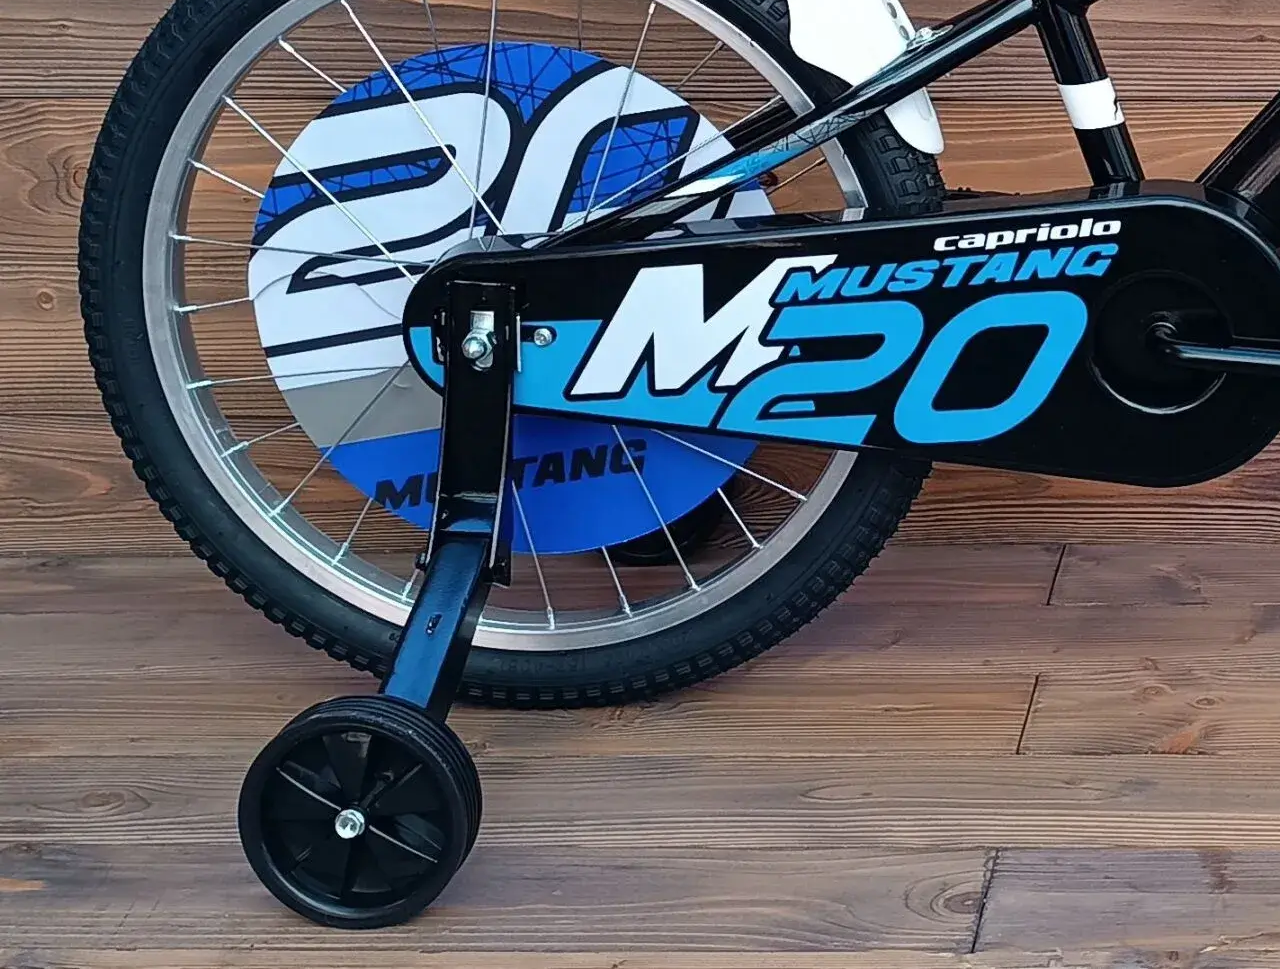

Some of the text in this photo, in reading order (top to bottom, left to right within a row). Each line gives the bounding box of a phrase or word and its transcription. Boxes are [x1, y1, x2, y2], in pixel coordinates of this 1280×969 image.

[933, 218, 1122, 253] capriolo
[778, 243, 1120, 302] MUSTANG
[375, 438, 647, 510] MTANG
